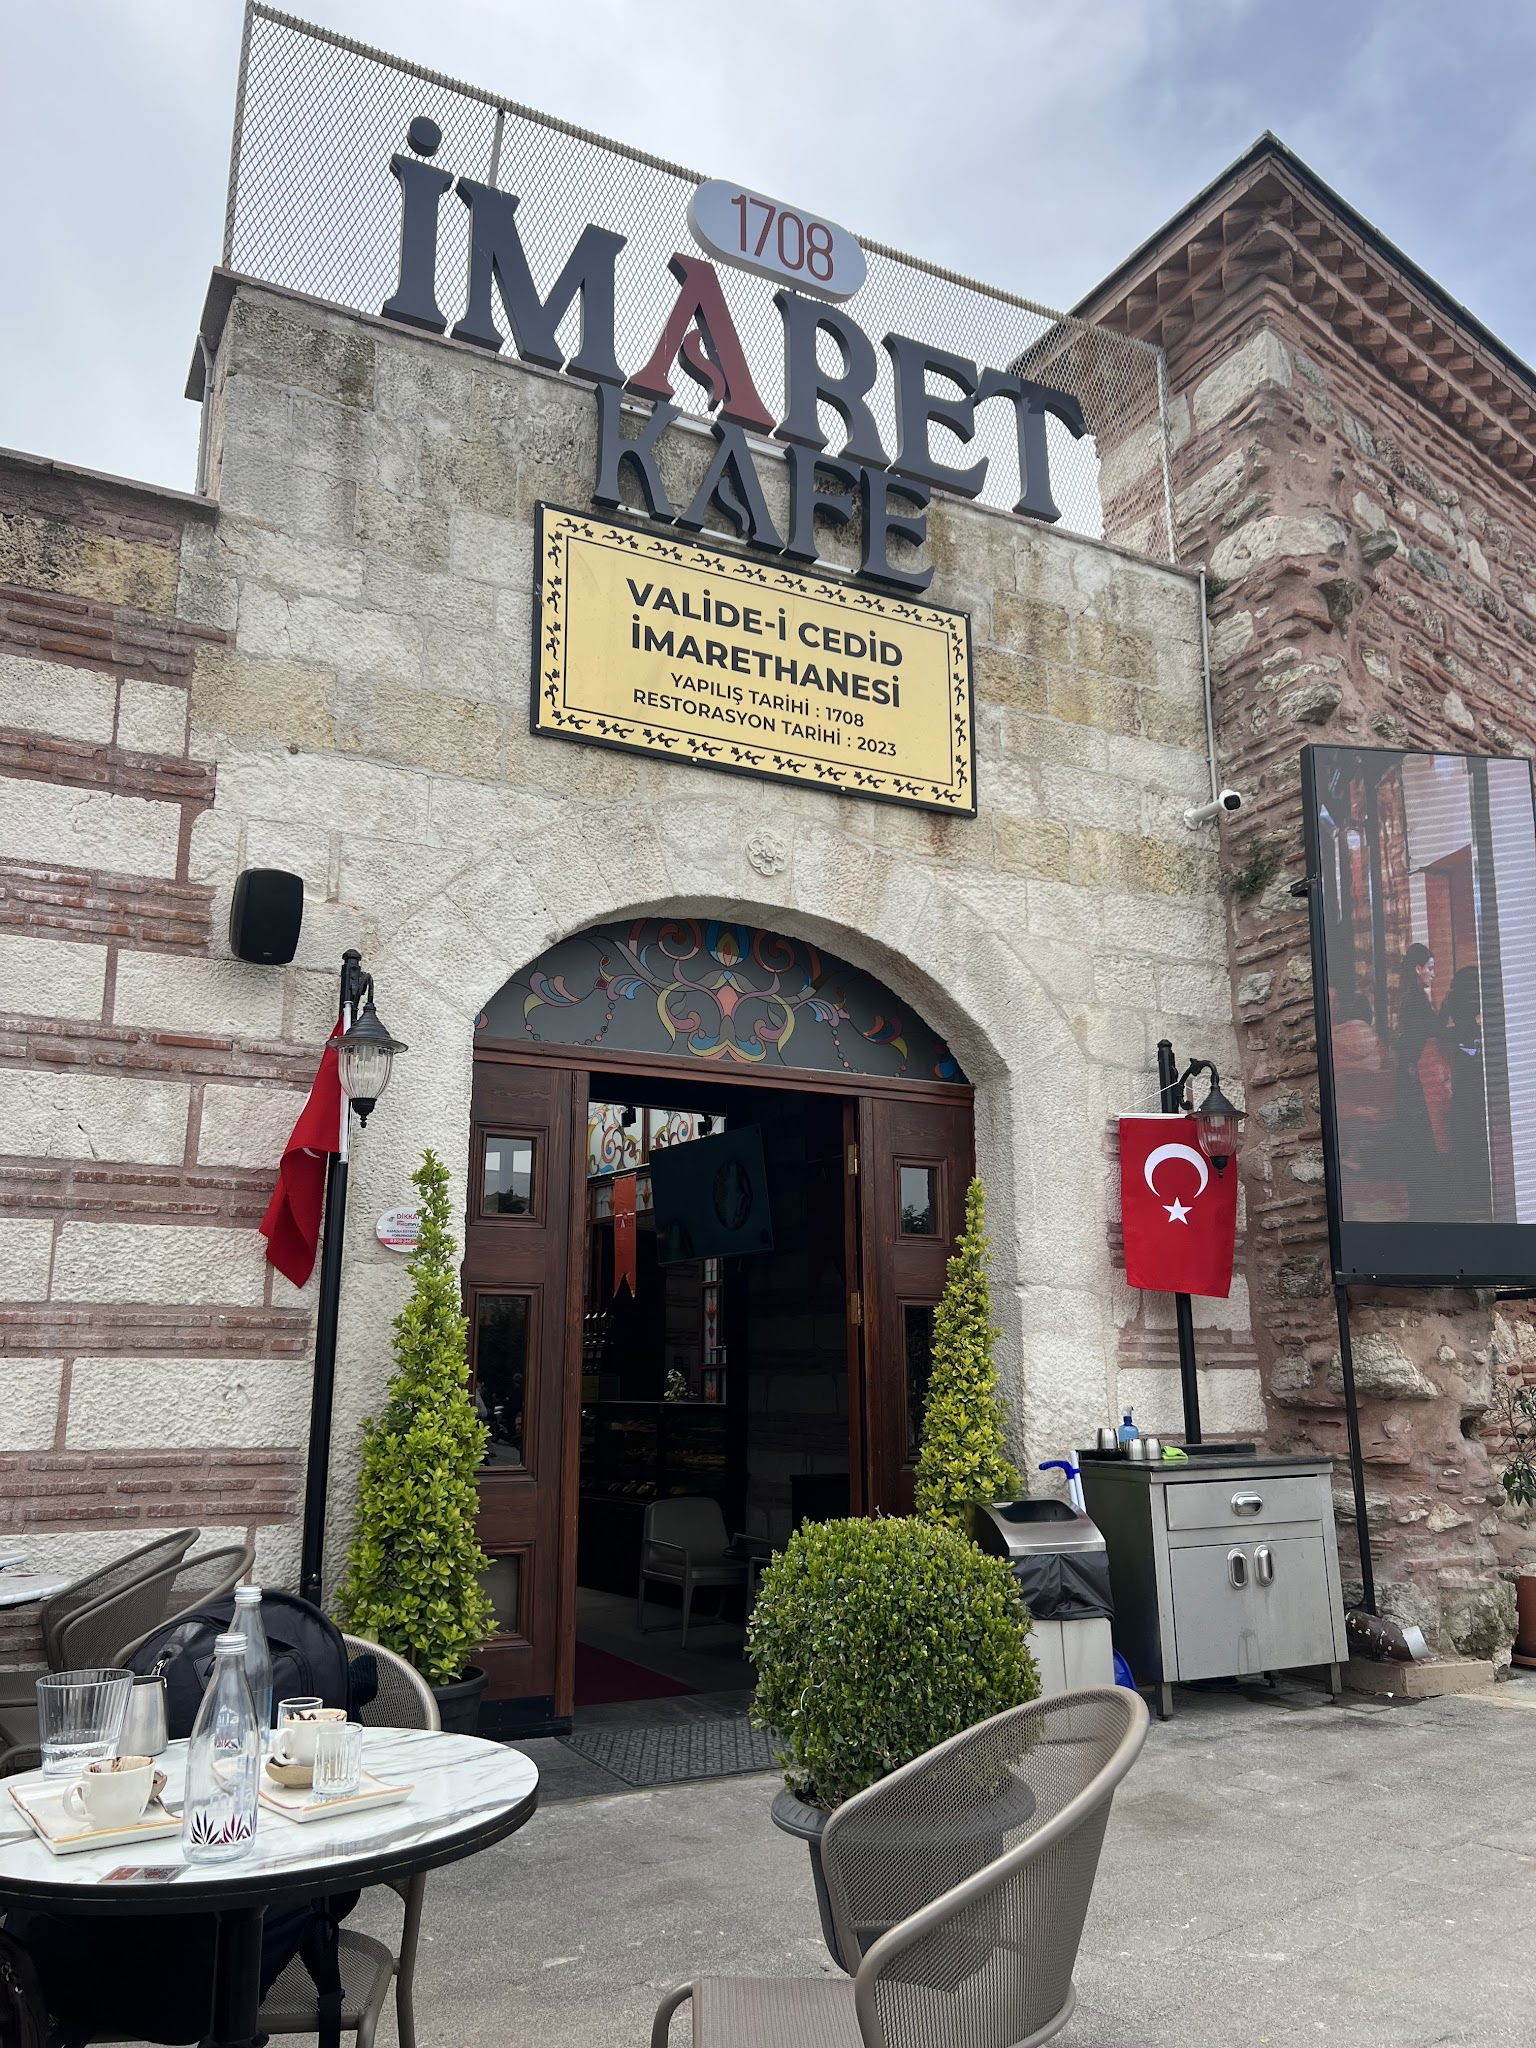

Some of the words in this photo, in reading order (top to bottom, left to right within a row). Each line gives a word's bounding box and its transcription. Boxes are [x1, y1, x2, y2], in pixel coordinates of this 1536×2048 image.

[732, 193, 835, 282] 1708
[382, 116, 1087, 523] İMARET
[592, 383, 935, 592] KAFE
[626, 578, 787, 641] VALİDE-İ
[798, 622, 903, 667] CEDİD
[631, 614, 900, 708] İMARETHANESİ
[633, 688, 775, 730] RESTORASYON
[781, 717, 842, 746] TARİHİ
[857, 736, 897, 757] 2023
[670, 672, 743, 705] YAPILIŞ
[748, 689, 810, 716] TARİHİ
[826, 707, 864, 727] 1708
